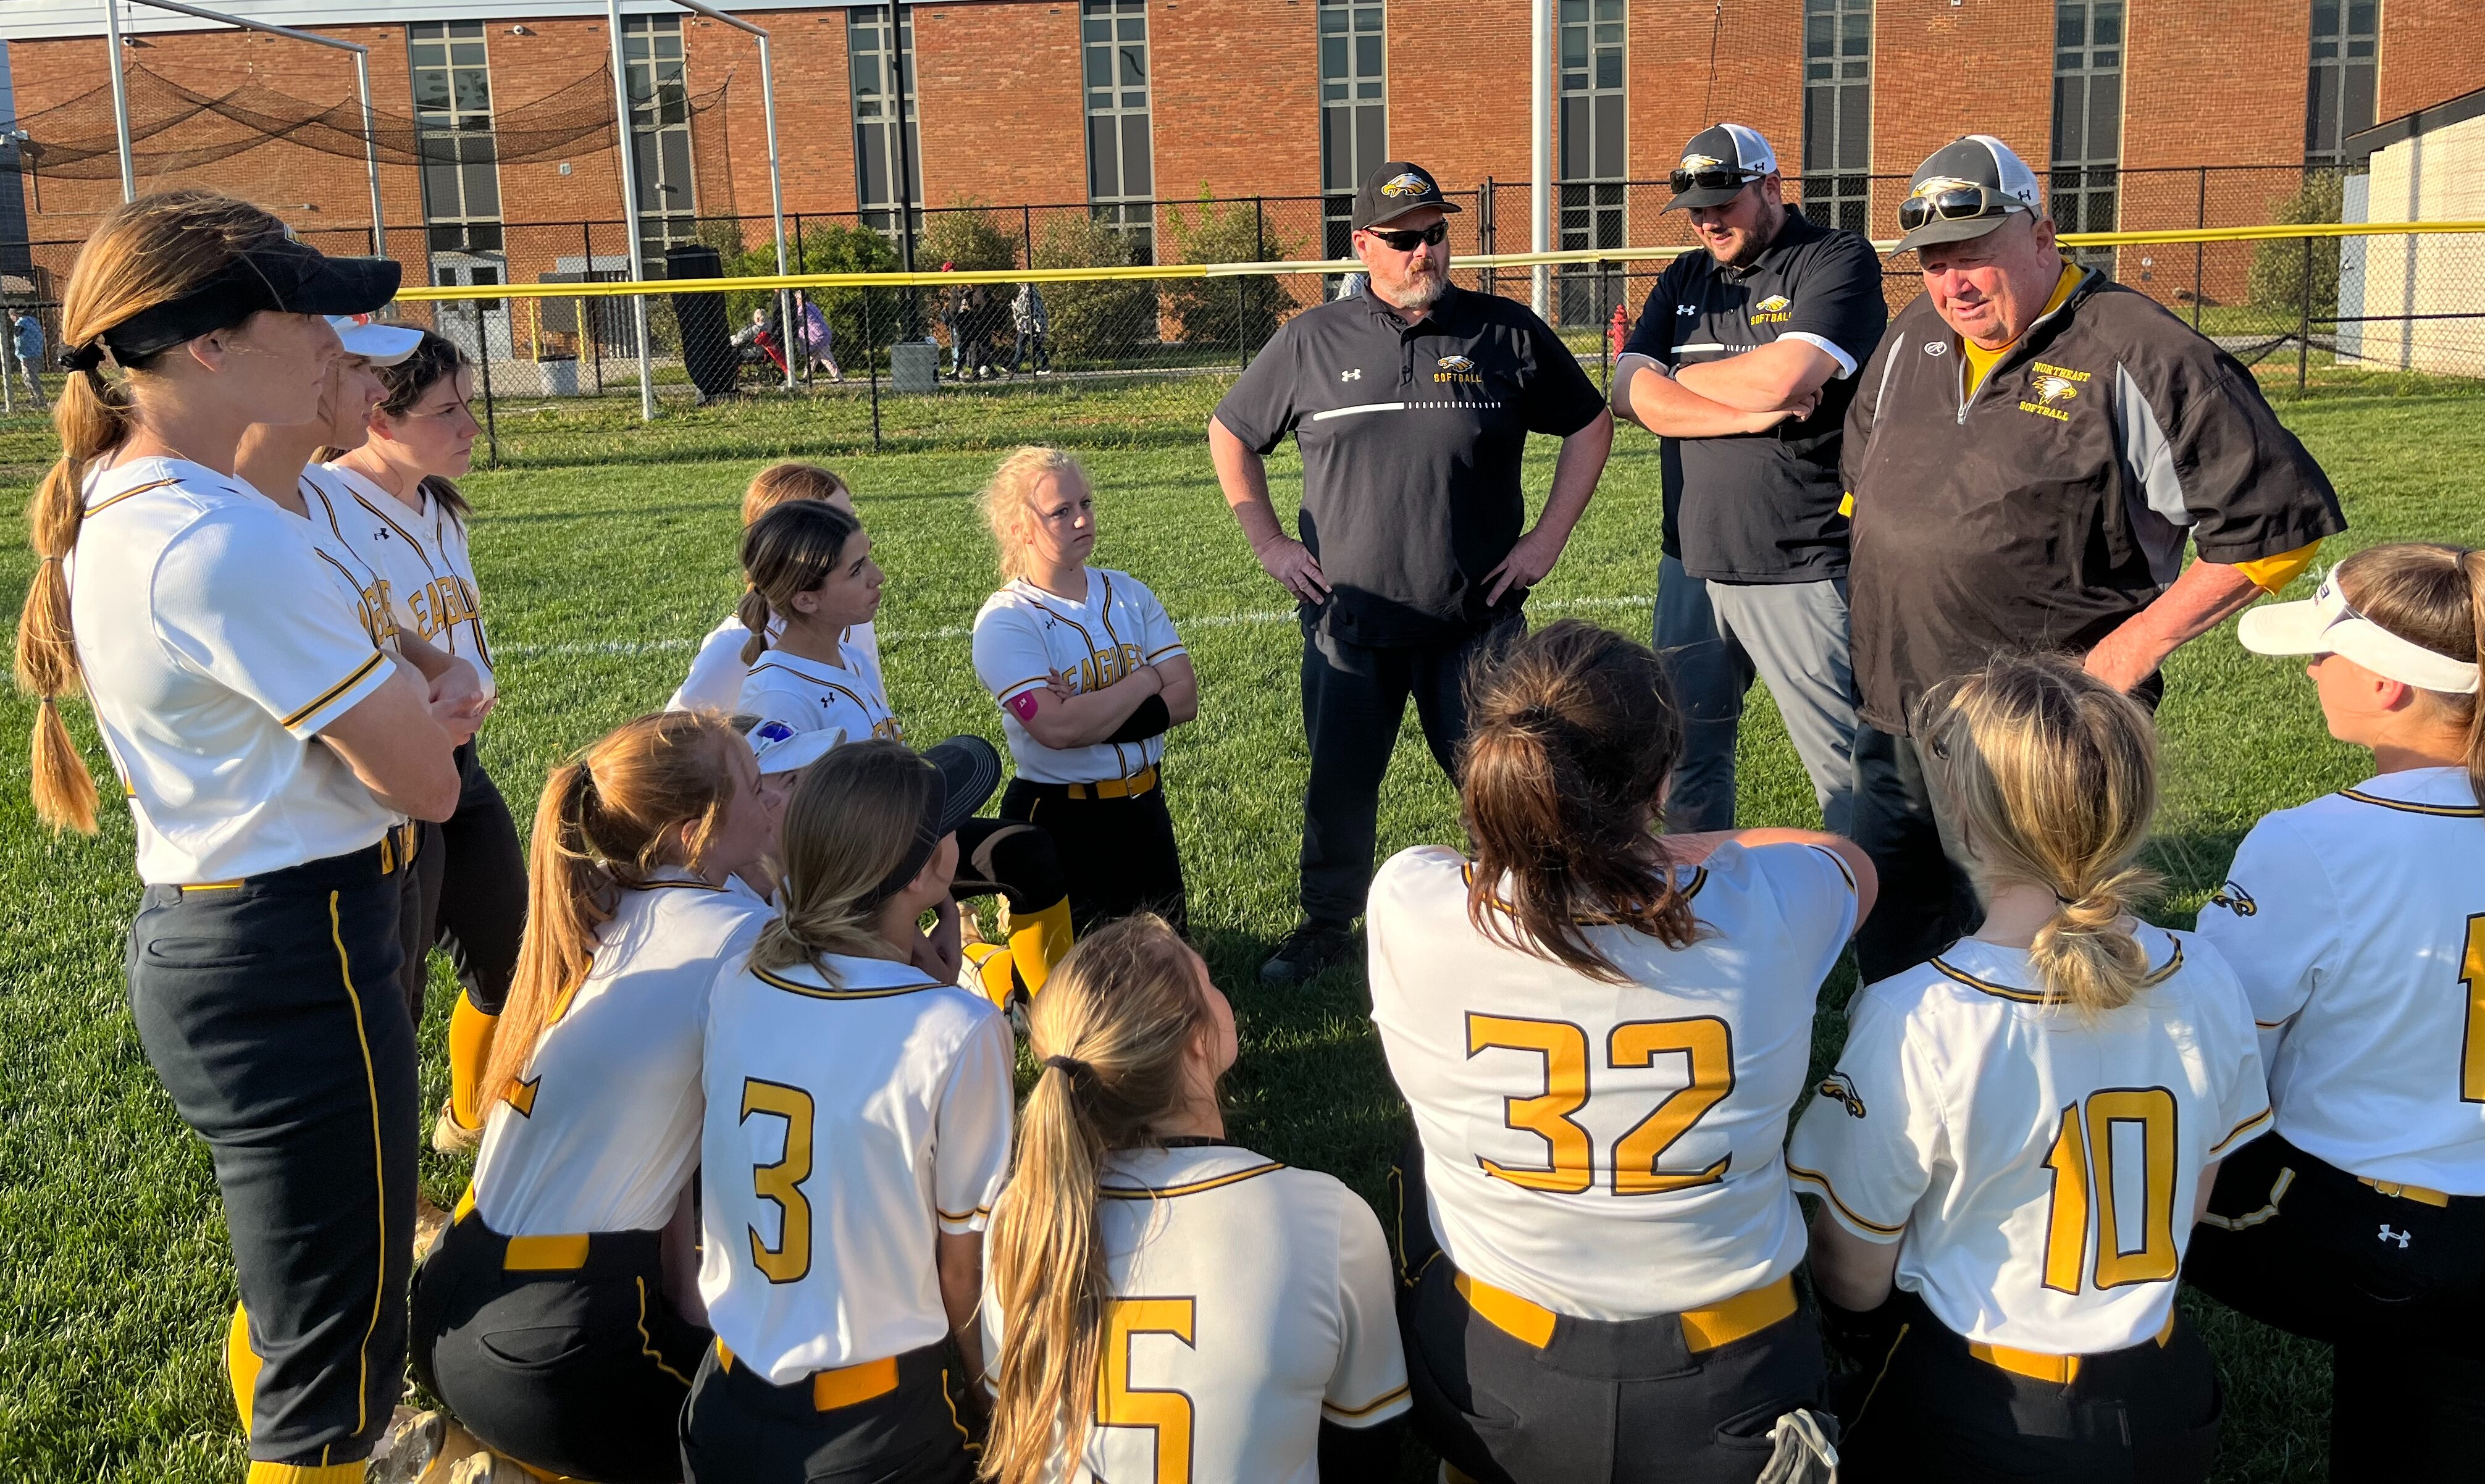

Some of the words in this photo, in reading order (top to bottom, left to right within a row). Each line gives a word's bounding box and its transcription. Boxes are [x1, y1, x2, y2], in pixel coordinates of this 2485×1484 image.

[1433, 372, 1482, 383] SOFTBALL
[2019, 401, 2069, 421] SOFTBALL
[2032, 361, 2092, 382] NORTHEAST
[740, 1076, 815, 1285] 3
[1464, 1010, 1736, 1196] 32
[2040, 1085, 2179, 1296] 10
[1092, 1296, 1197, 1484] 5
